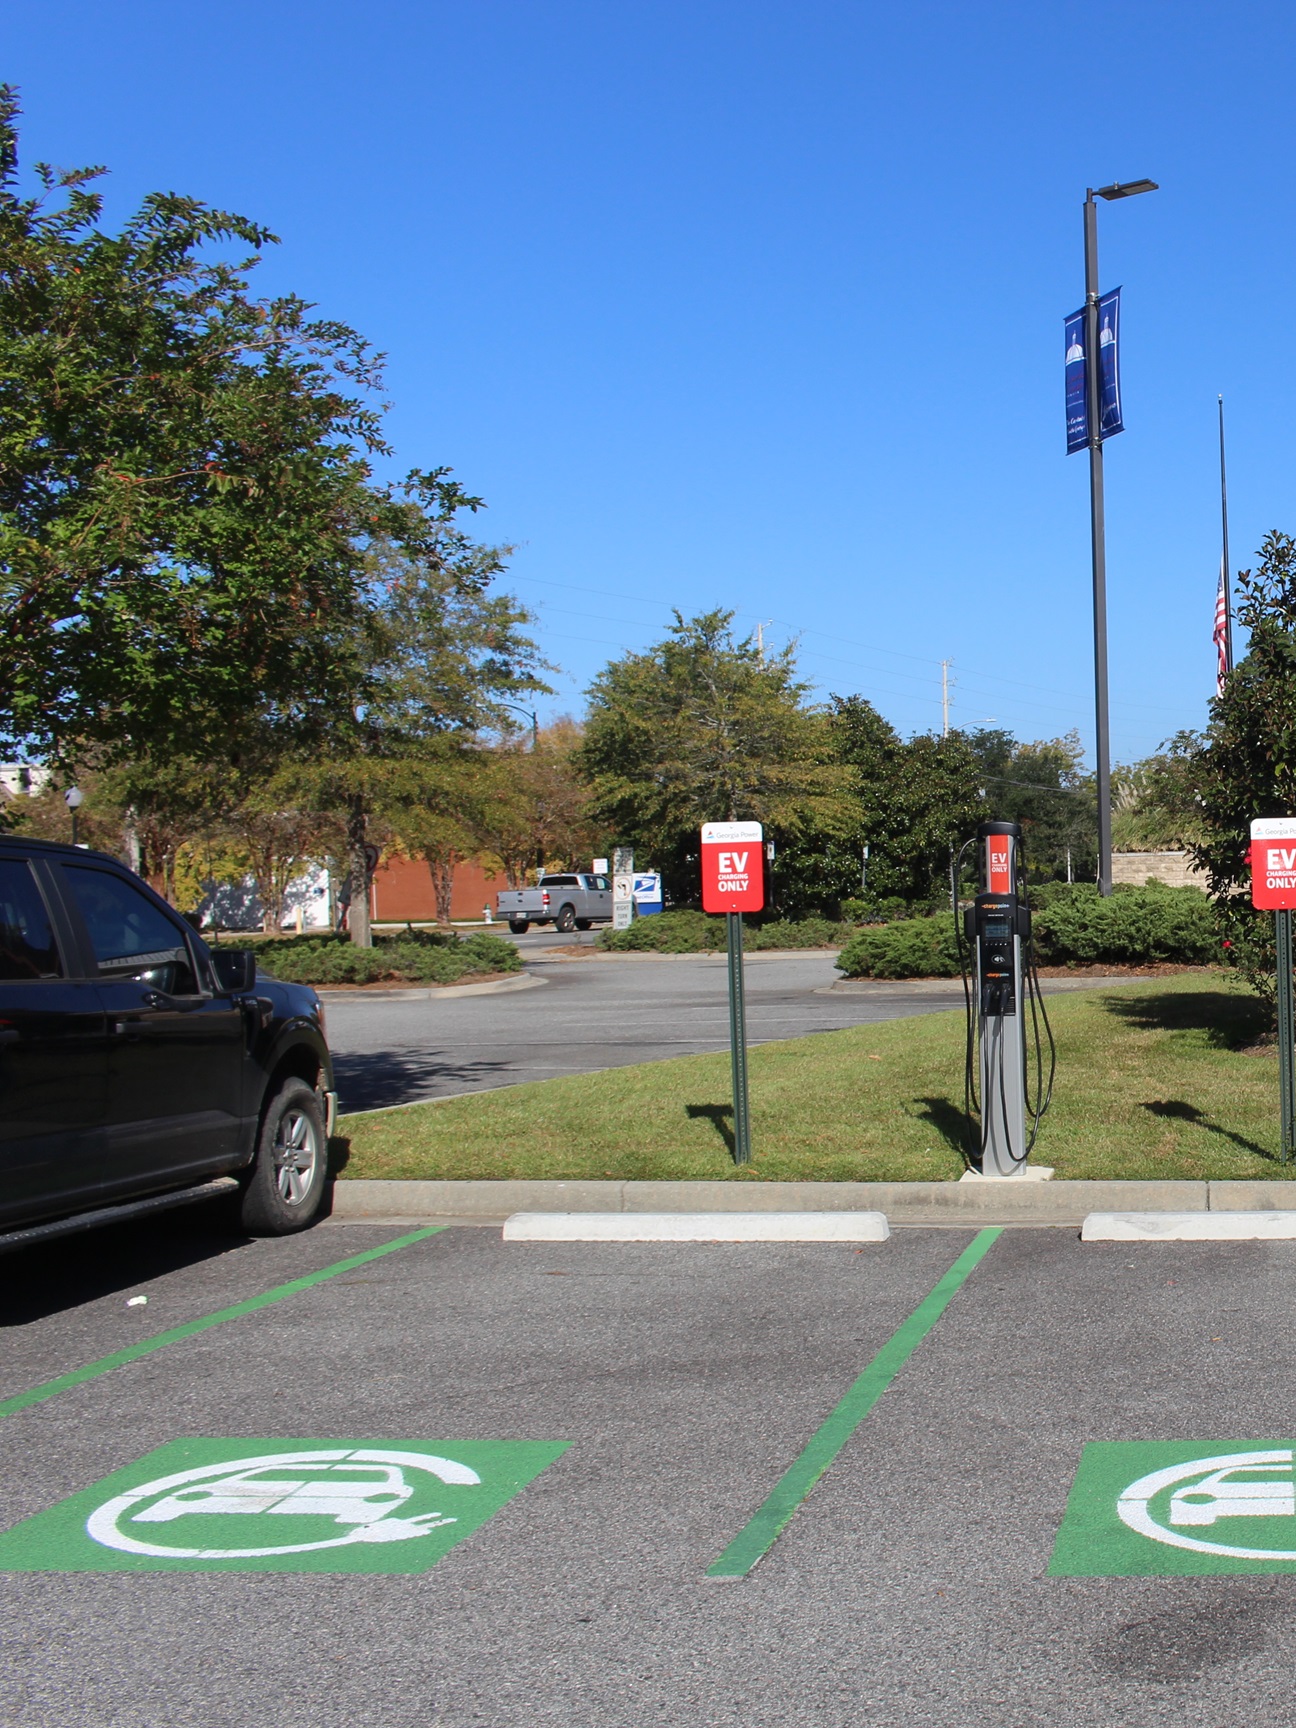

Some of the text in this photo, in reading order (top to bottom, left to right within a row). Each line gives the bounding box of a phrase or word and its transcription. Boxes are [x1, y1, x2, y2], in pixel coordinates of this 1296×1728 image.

[718, 852, 748, 873] EV
[991, 853, 1007, 863] EV
[1267, 848, 1296, 870] EV
[718, 880, 749, 892] ONLY
[1266, 877, 1296, 888] ONLY
